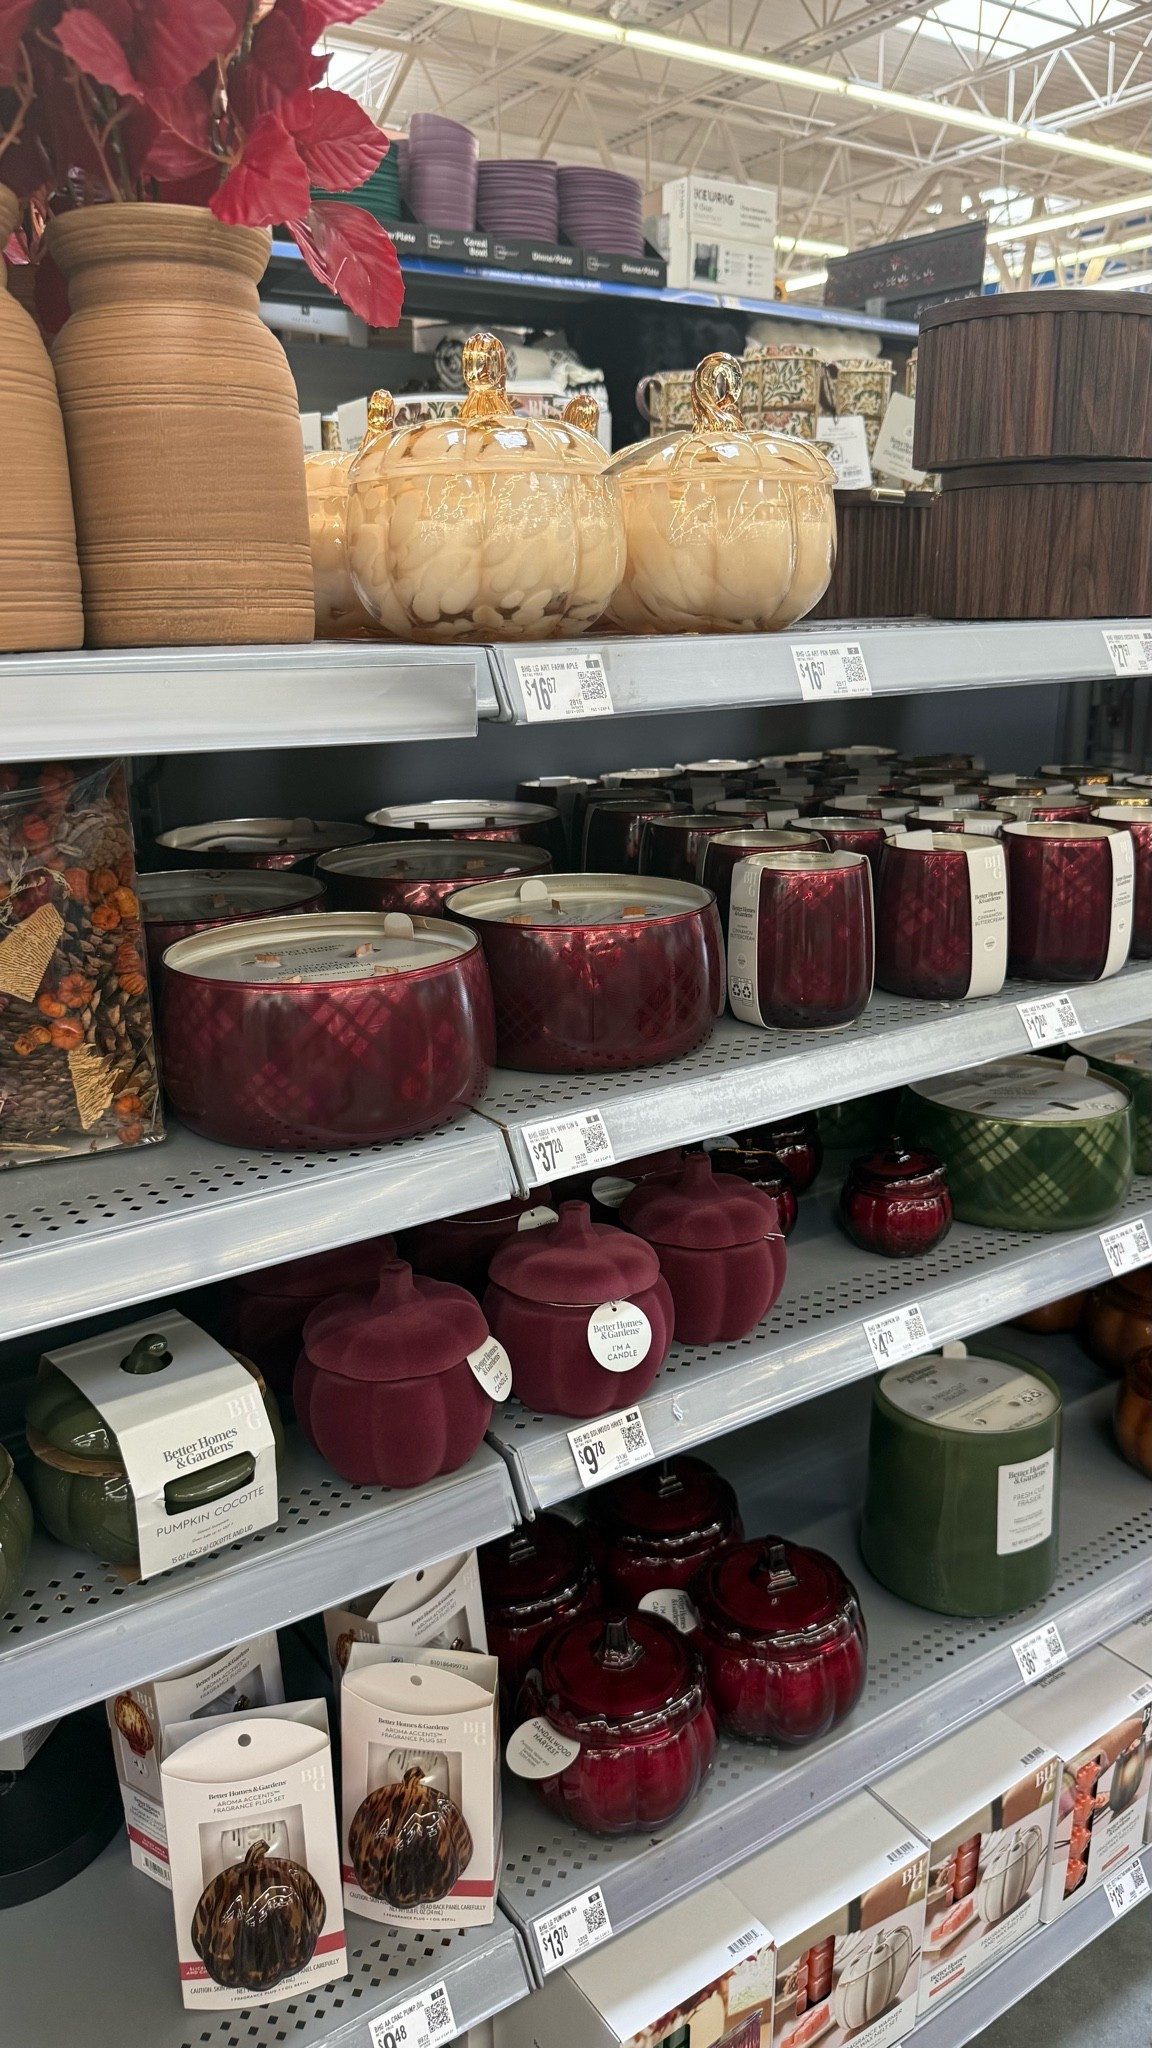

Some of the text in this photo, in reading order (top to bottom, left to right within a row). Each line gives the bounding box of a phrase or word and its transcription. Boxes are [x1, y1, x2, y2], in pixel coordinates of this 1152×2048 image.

[694, 188, 735, 206] KEURIG
[521, 662, 579, 673] BHG LG ART FARM APLE
[525, 677, 557, 710] $1667
[993, 866, 1002, 879] G
[987, 890, 1004, 898] Homes
[975, 916, 1005, 926] BUTTERCREAM
[977, 912, 1002, 921] CINNAMON
[532, 1138, 564, 1171] $3728
[593, 1319, 644, 1334] Better Homes
[607, 1327, 641, 1338] Gardens
[612, 1344, 624, 1352] I'M
[872, 1330, 894, 1357] $478
[474, 1345, 498, 1372] Better Homes
[485, 1352, 501, 1372] Gardens
[607, 1350, 638, 1361] CANDLE
[494, 1373, 509, 1393] CANDLE
[227, 1392, 257, 1419] BH
[246, 1410, 262, 1431] G
[163, 1427, 238, 1463] Better Homes
[176, 1441, 234, 1470] & Gardens
[578, 1440, 606, 1474] $978
[1008, 1461, 1050, 1479] Better Homes
[1020, 1470, 1046, 1483] Gardens
[1013, 1484, 1045, 1501] FRESH CUT
[1017, 1494, 1042, 1507] FRASIER
[156, 1511, 210, 1538] PUMPKIN
[214, 1485, 265, 1516] COCOTTE
[178, 1553, 186, 1562] OZ
[209, 1534, 232, 1549] COCOTTE
[232, 1528, 244, 1539] AND
[244, 1523, 254, 1533] LID
[378, 1717, 450, 1731] Better Homes Gardens
[385, 1727, 408, 1735] AROMA
[463, 1721, 486, 1734] BH
[381, 1732, 418, 1742] FRAGRANCE
[474, 1735, 486, 1745] G
[532, 1720, 572, 1757] SANDALWOOD
[533, 1733, 559, 1756] HARVEST
[301, 1765, 325, 1783] BH
[208, 1793, 228, 1801] Better
[228, 1788, 253, 1798] Homes
[258, 1780, 286, 1791] Gardens
[313, 1780, 325, 1792] G
[213, 1794, 285, 1814] FRAGRANCE PLUG SET
[217, 1798, 242, 1807] AROMA
[911, 1873, 922, 1893] G
[539, 1906, 578, 1932] BHG LG PUMPKIN SH
[542, 1925, 569, 1960] $1378
[313, 1958, 340, 1971] CAREFULLY
[930, 1966, 948, 1982] Better
[947, 1954, 967, 1970] Homes
[234, 1992, 263, 2001] FRAGRANCE
[374, 2019, 392, 2033] BHG AA
